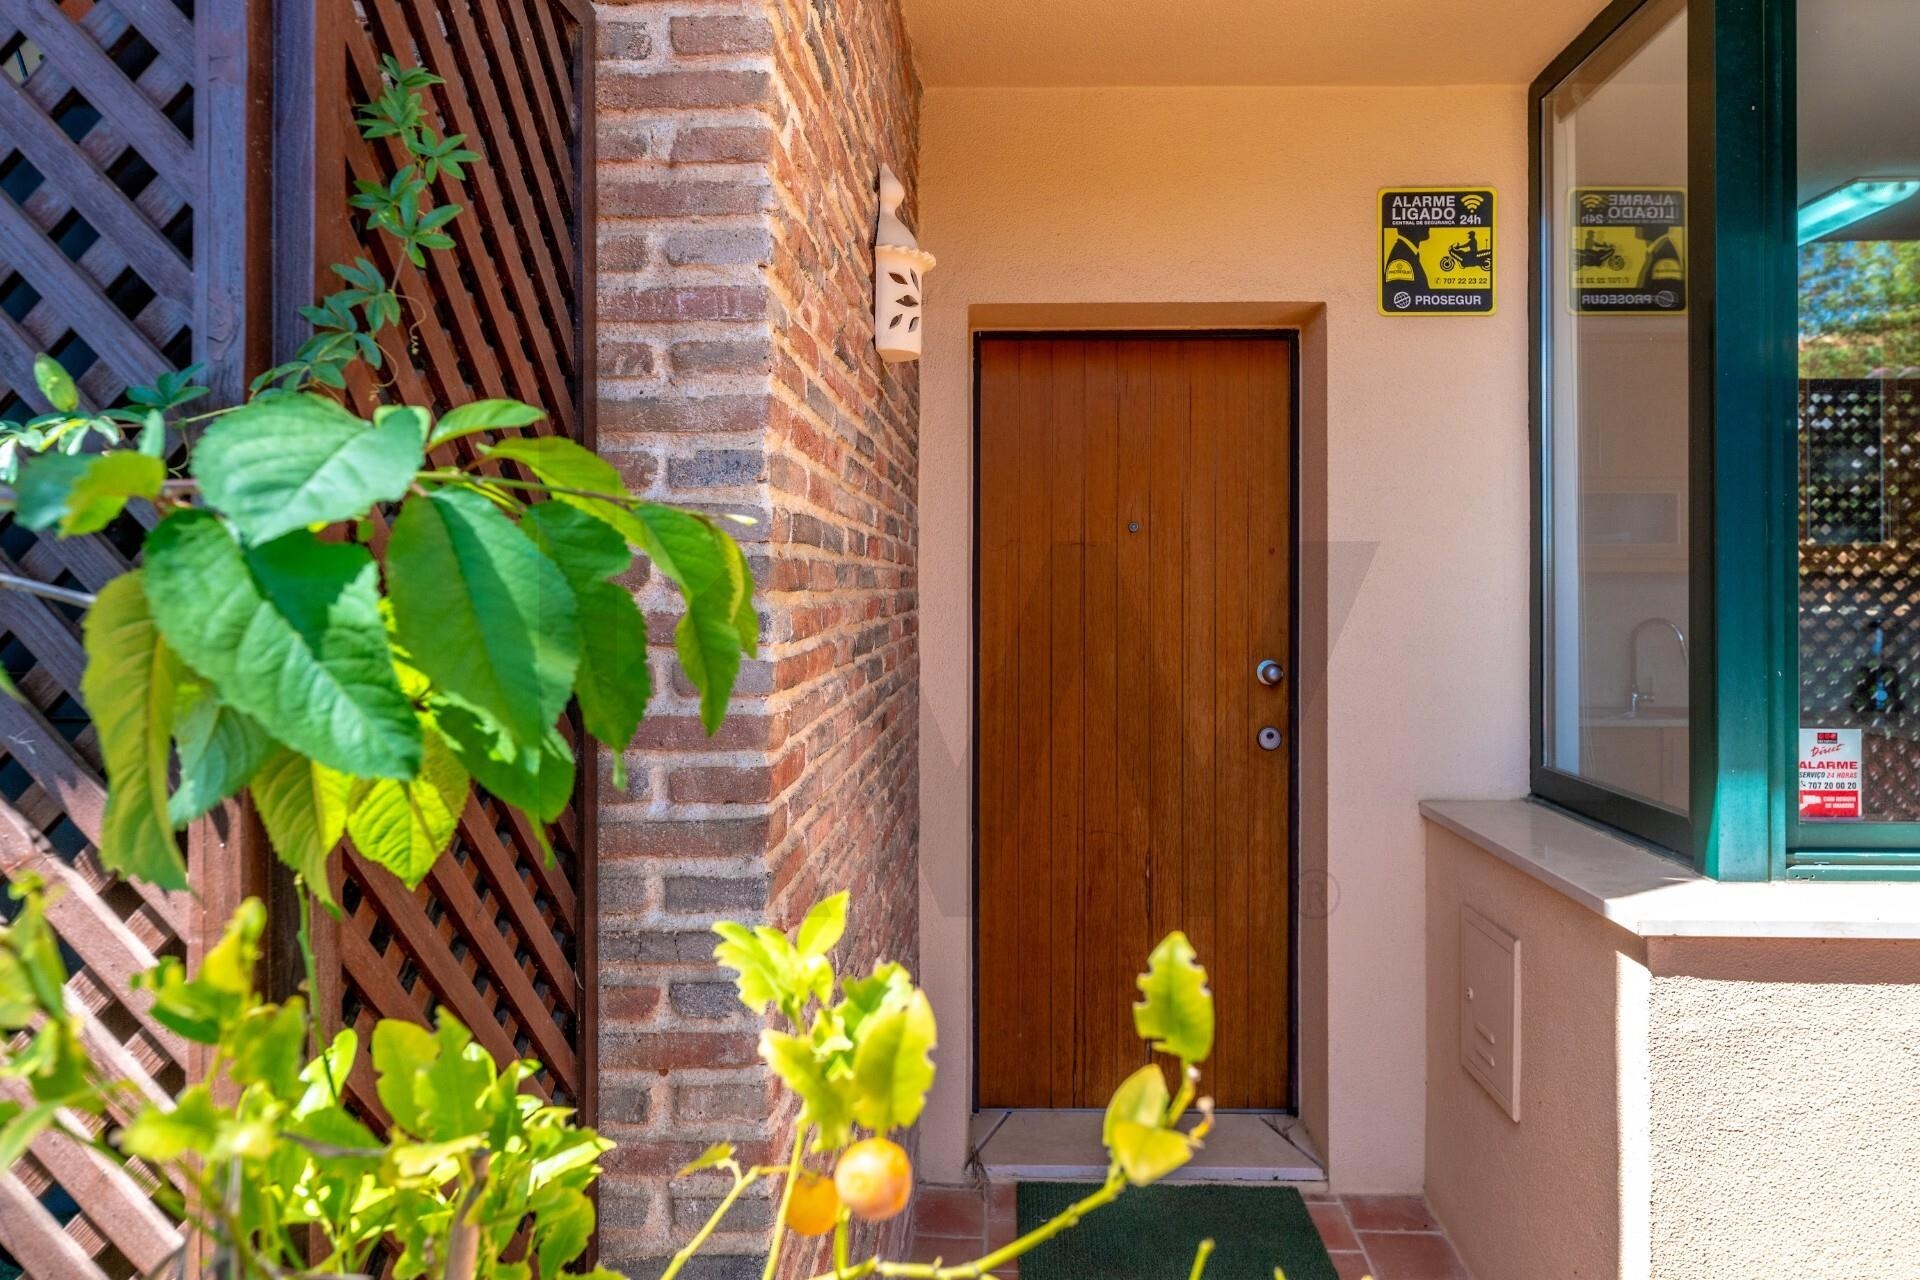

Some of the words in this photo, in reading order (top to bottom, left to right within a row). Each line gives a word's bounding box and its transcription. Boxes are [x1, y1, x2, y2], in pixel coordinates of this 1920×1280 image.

[1392, 195, 1456, 207] ALARME
[1392, 207, 1456, 220] LIGADO
[1459, 214, 1482, 225] 24h
[1415, 295, 1482, 305] PROSEGUR
[1799, 761, 1858, 769] ALARME
